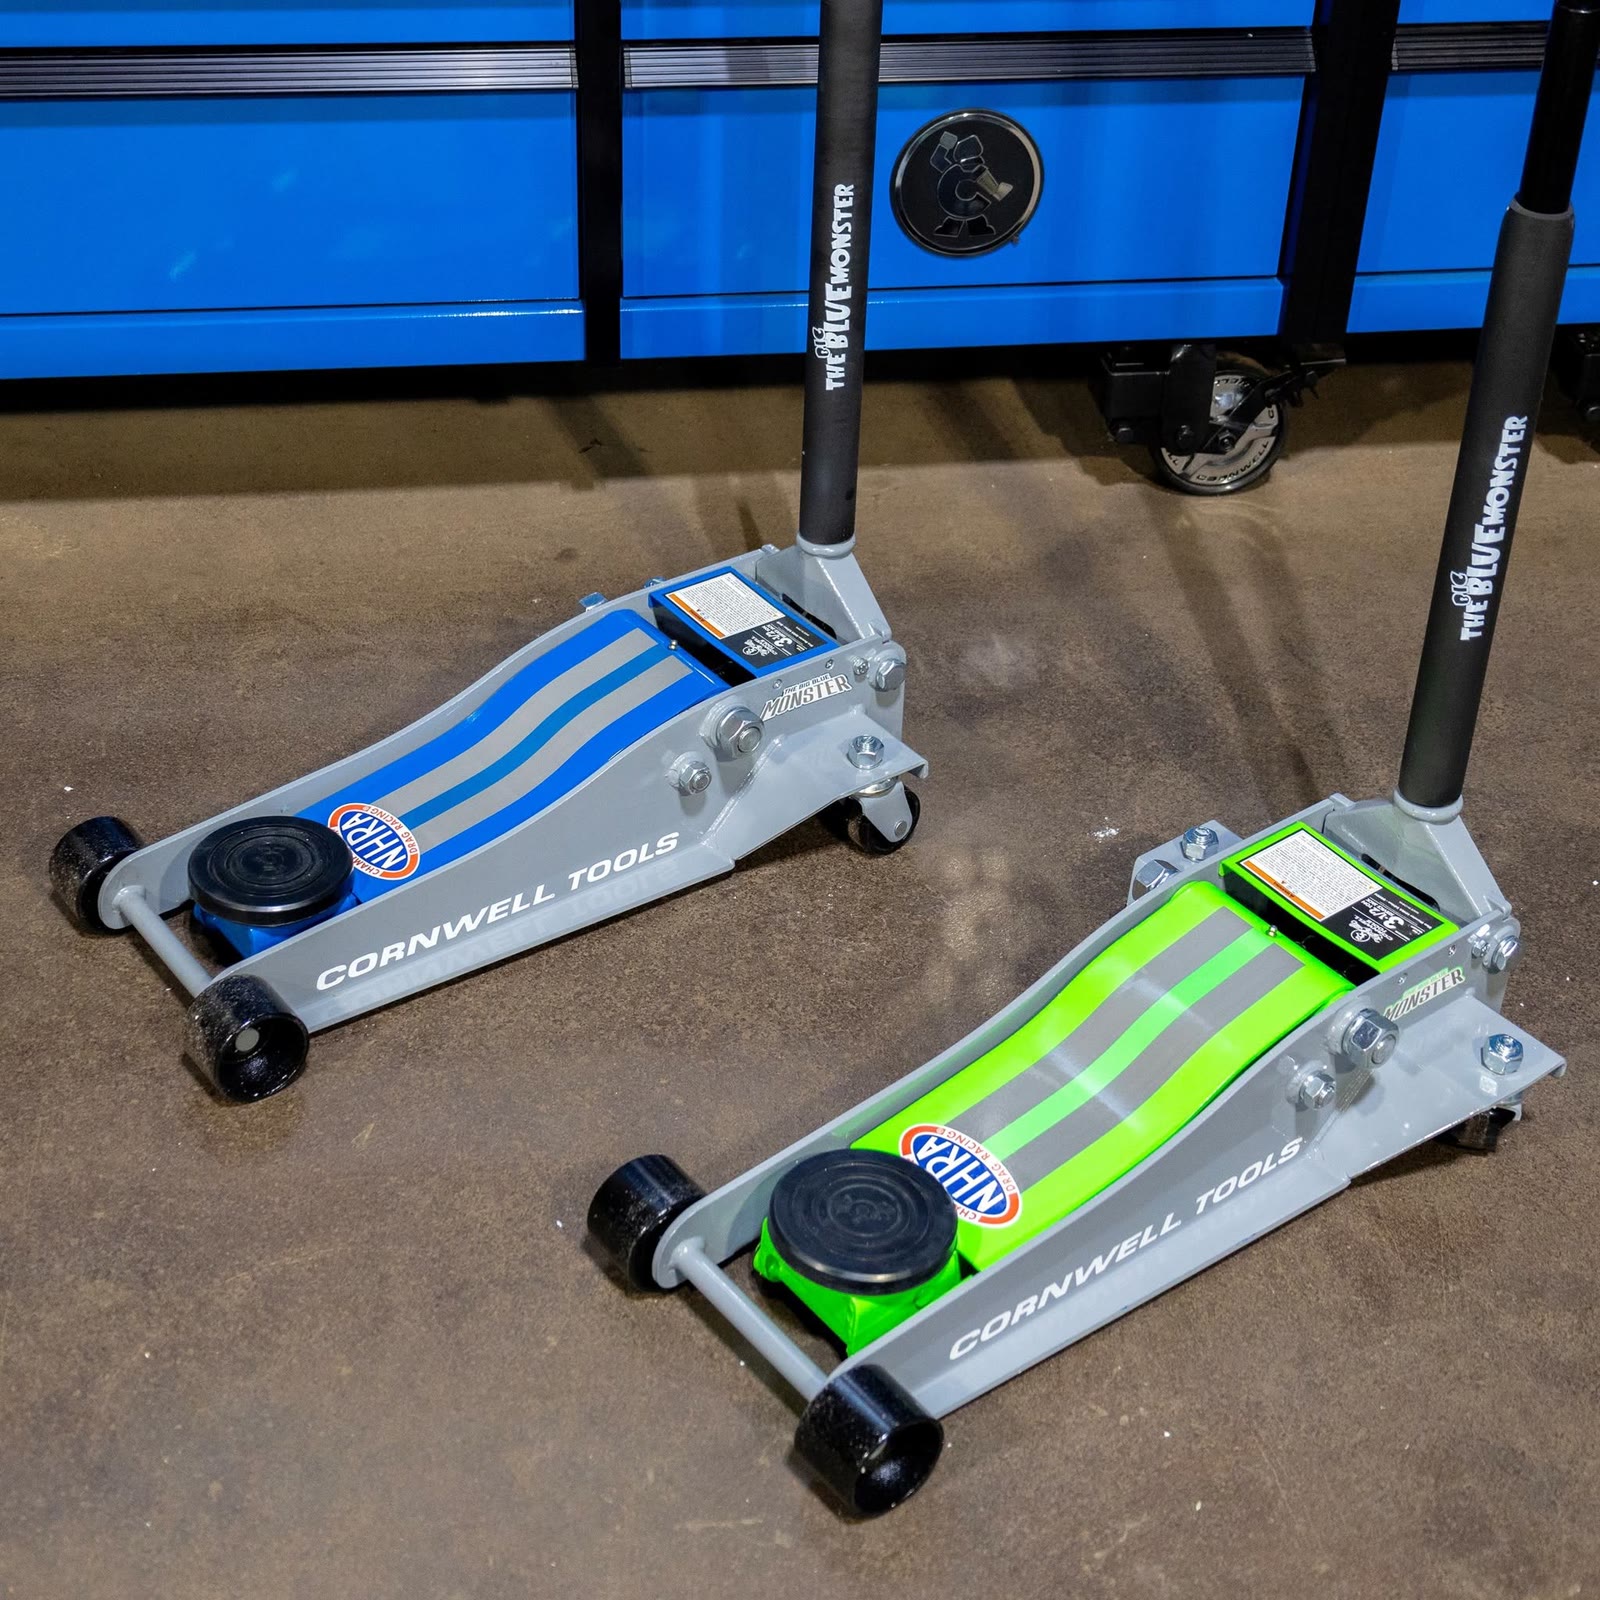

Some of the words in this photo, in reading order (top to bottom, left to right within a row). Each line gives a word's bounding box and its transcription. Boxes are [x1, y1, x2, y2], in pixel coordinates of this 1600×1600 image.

[829, 183, 855, 285] MONSTER
[823, 282, 852, 349] BLUE
[812, 326, 831, 359] BIG
[825, 353, 846, 391] THE
[1196, 440, 1270, 483] CORNWELL
[1482, 415, 1528, 526] MONSTER
[1466, 523, 1506, 596] BLUE
[1450, 570, 1472, 606] BIG
[1460, 600, 1488, 641] THE
[761, 673, 851, 720] MONSTER
[798, 680, 811, 690] BIG
[341, 811, 407, 870] NHRA
[401, 830, 418, 854] DRAG
[316, 883, 556, 991] CORNWELL
[568, 831, 680, 891] TOOLS
[916, 1135, 1005, 1213] NHRA
[992, 1162, 1016, 1193] DRAG
[949, 1212, 1183, 1361] CORNWELL
[1196, 1136, 1303, 1215] TOOLS
